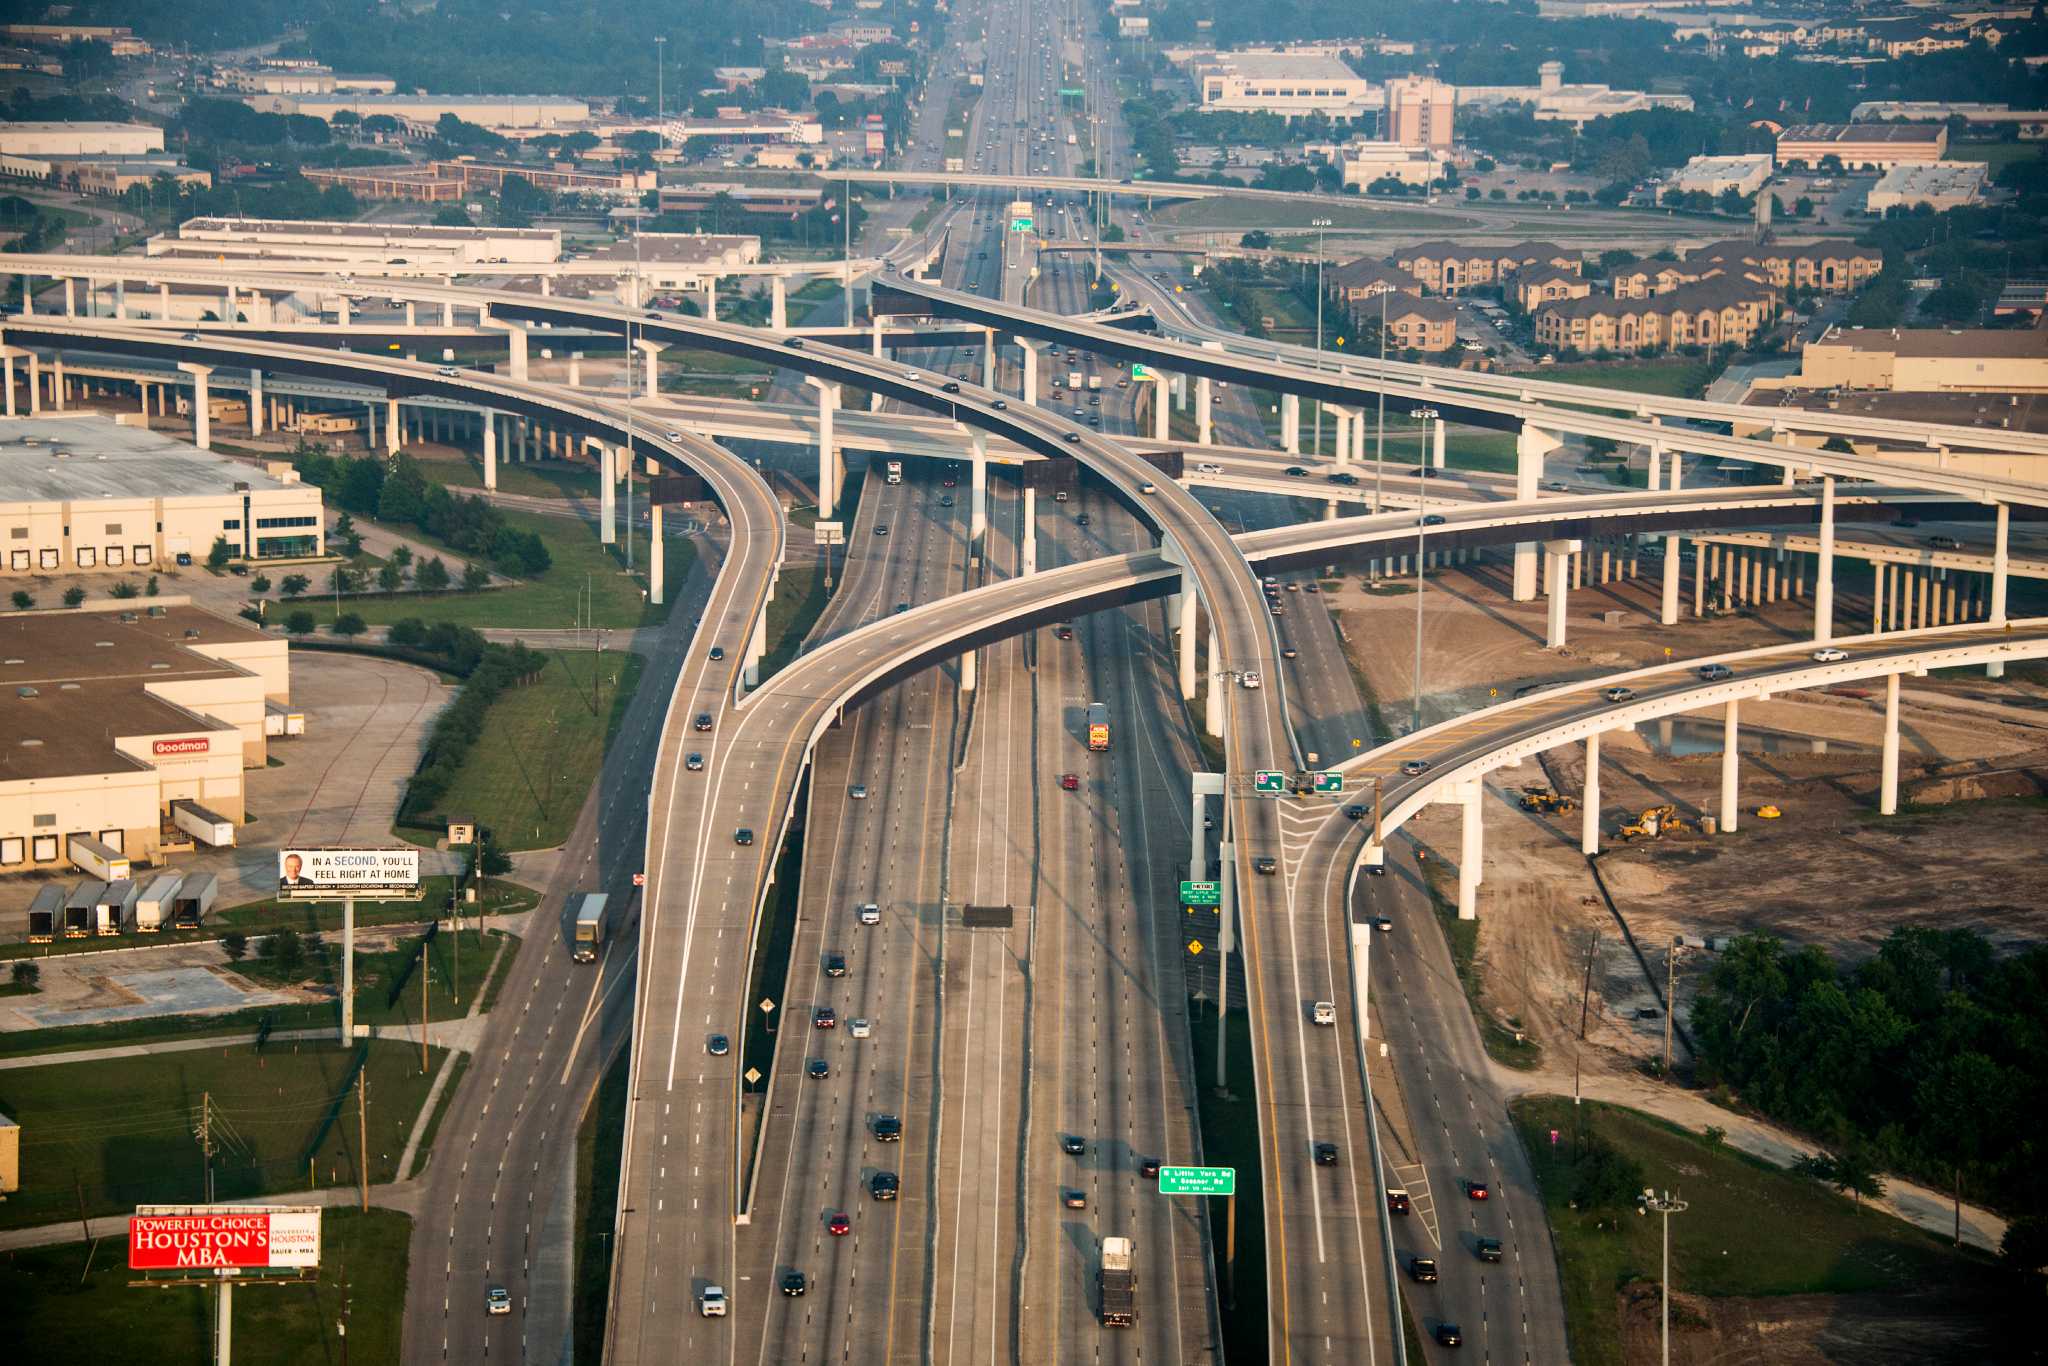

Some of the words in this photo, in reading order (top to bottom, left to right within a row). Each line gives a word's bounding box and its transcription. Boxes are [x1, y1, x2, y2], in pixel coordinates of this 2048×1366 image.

[156, 742, 207, 753] Goodman
[312, 857, 322, 866] IN
[325, 857, 331, 866] A
[334, 856, 379, 867] SECOND,
[382, 857, 413, 866] YOU'LL
[315, 870, 336, 879] FEEL
[340, 870, 366, 879] RIGHT
[370, 870, 381, 879] AT
[384, 869, 410, 879] HOME
[136, 1218, 208, 1231] POWERFUL
[210, 1217, 266, 1230] CHOICE.
[136, 1231, 267, 1249] HOUSTON'S
[270, 1235, 315, 1244] HOUSTON
[176, 1248, 233, 1266] MBA.
